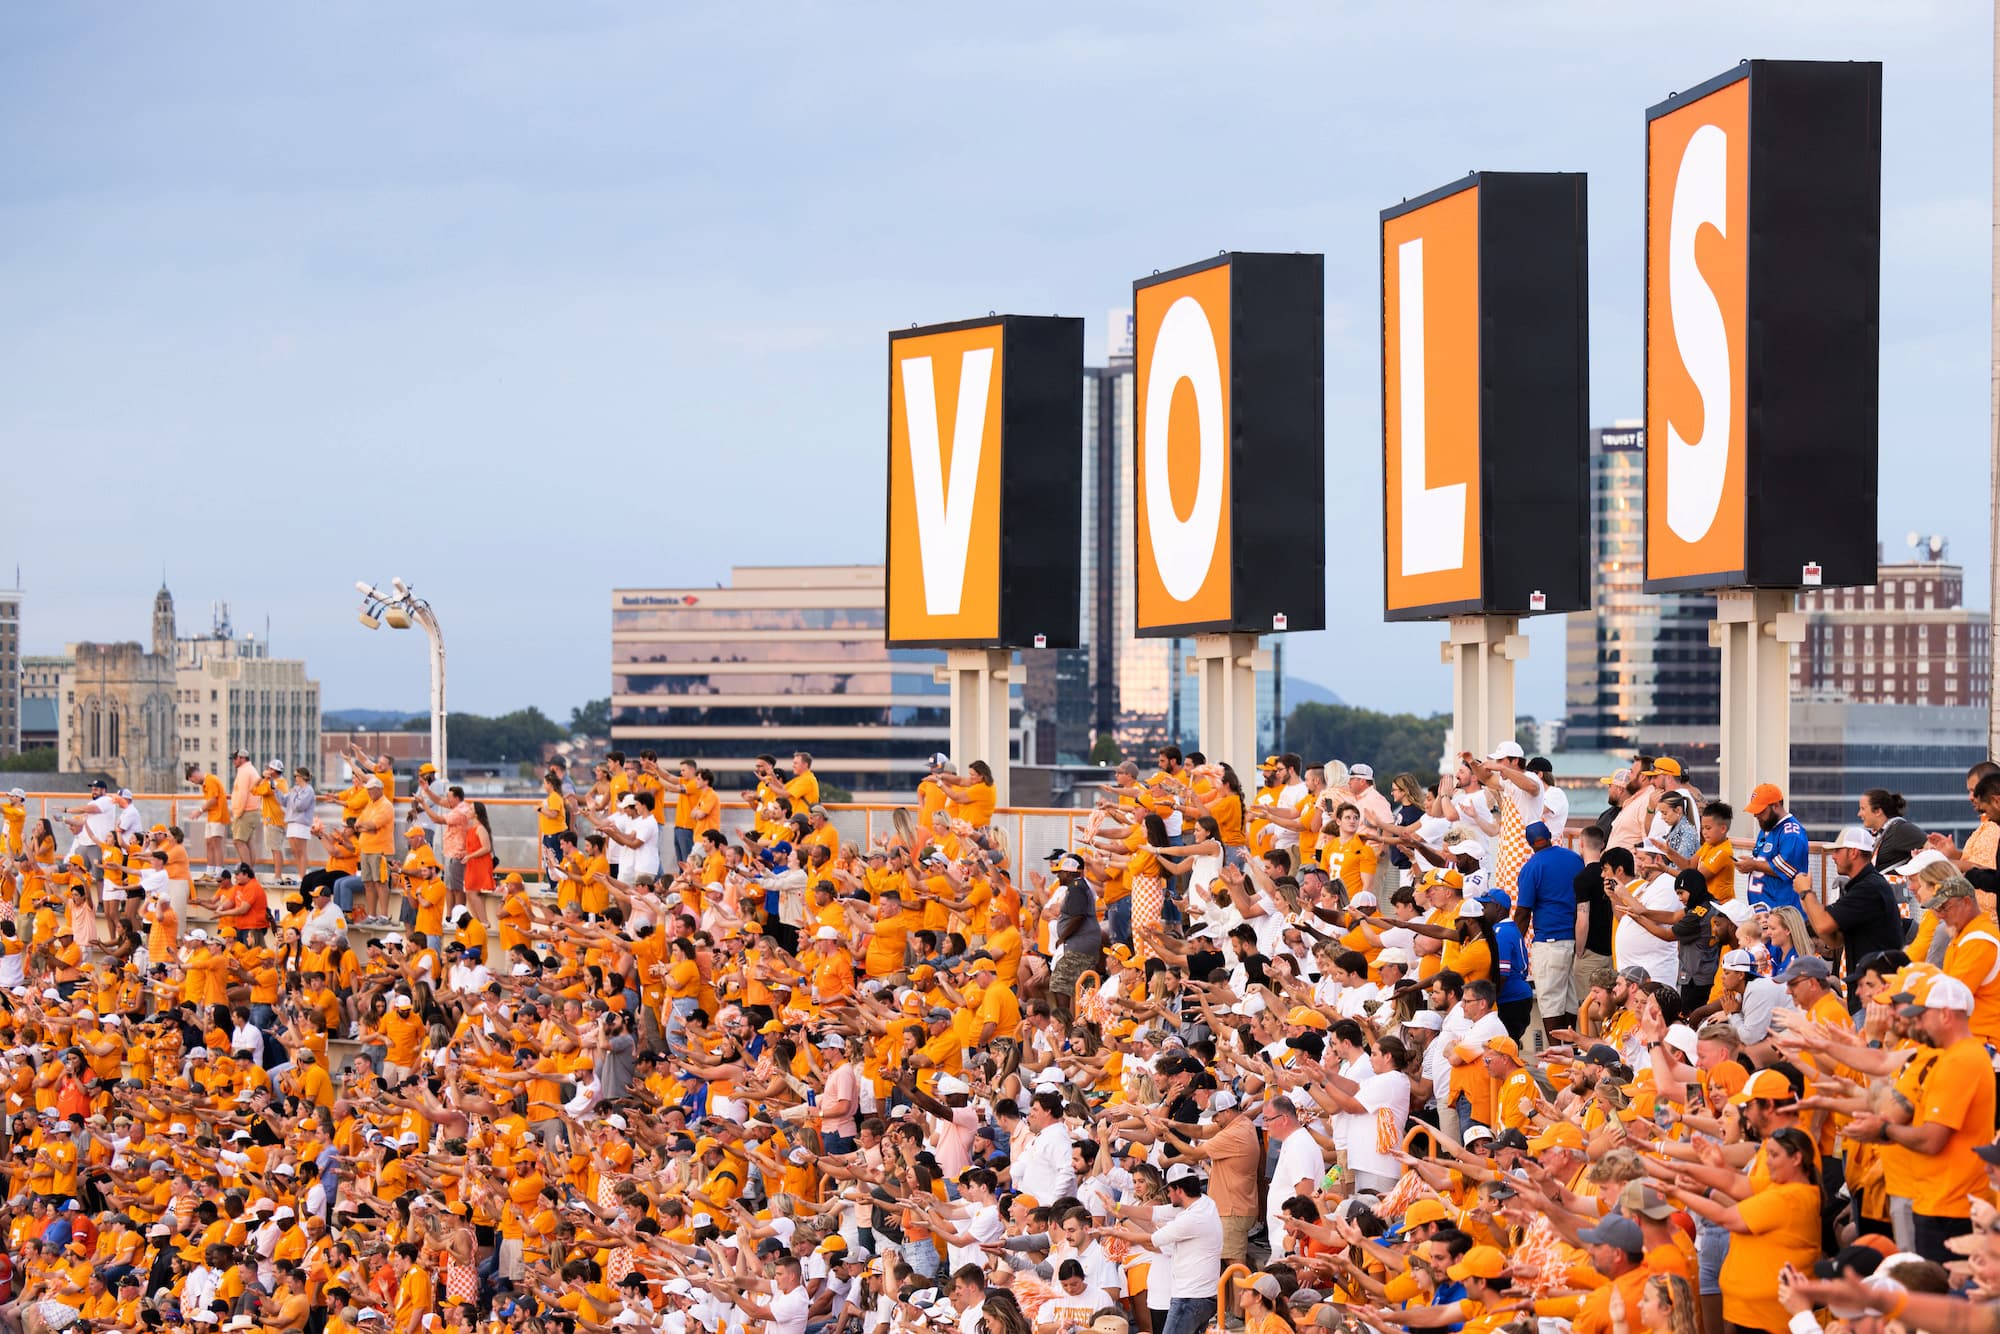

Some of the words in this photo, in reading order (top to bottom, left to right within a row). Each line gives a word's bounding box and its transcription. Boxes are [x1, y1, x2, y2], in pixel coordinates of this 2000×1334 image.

[1602, 433, 1636, 446] TRUIST
[1783, 822, 1801, 835] 22
[1329, 852, 1345, 881] 6
[1054, 1306, 1095, 1329] TNNESSE
